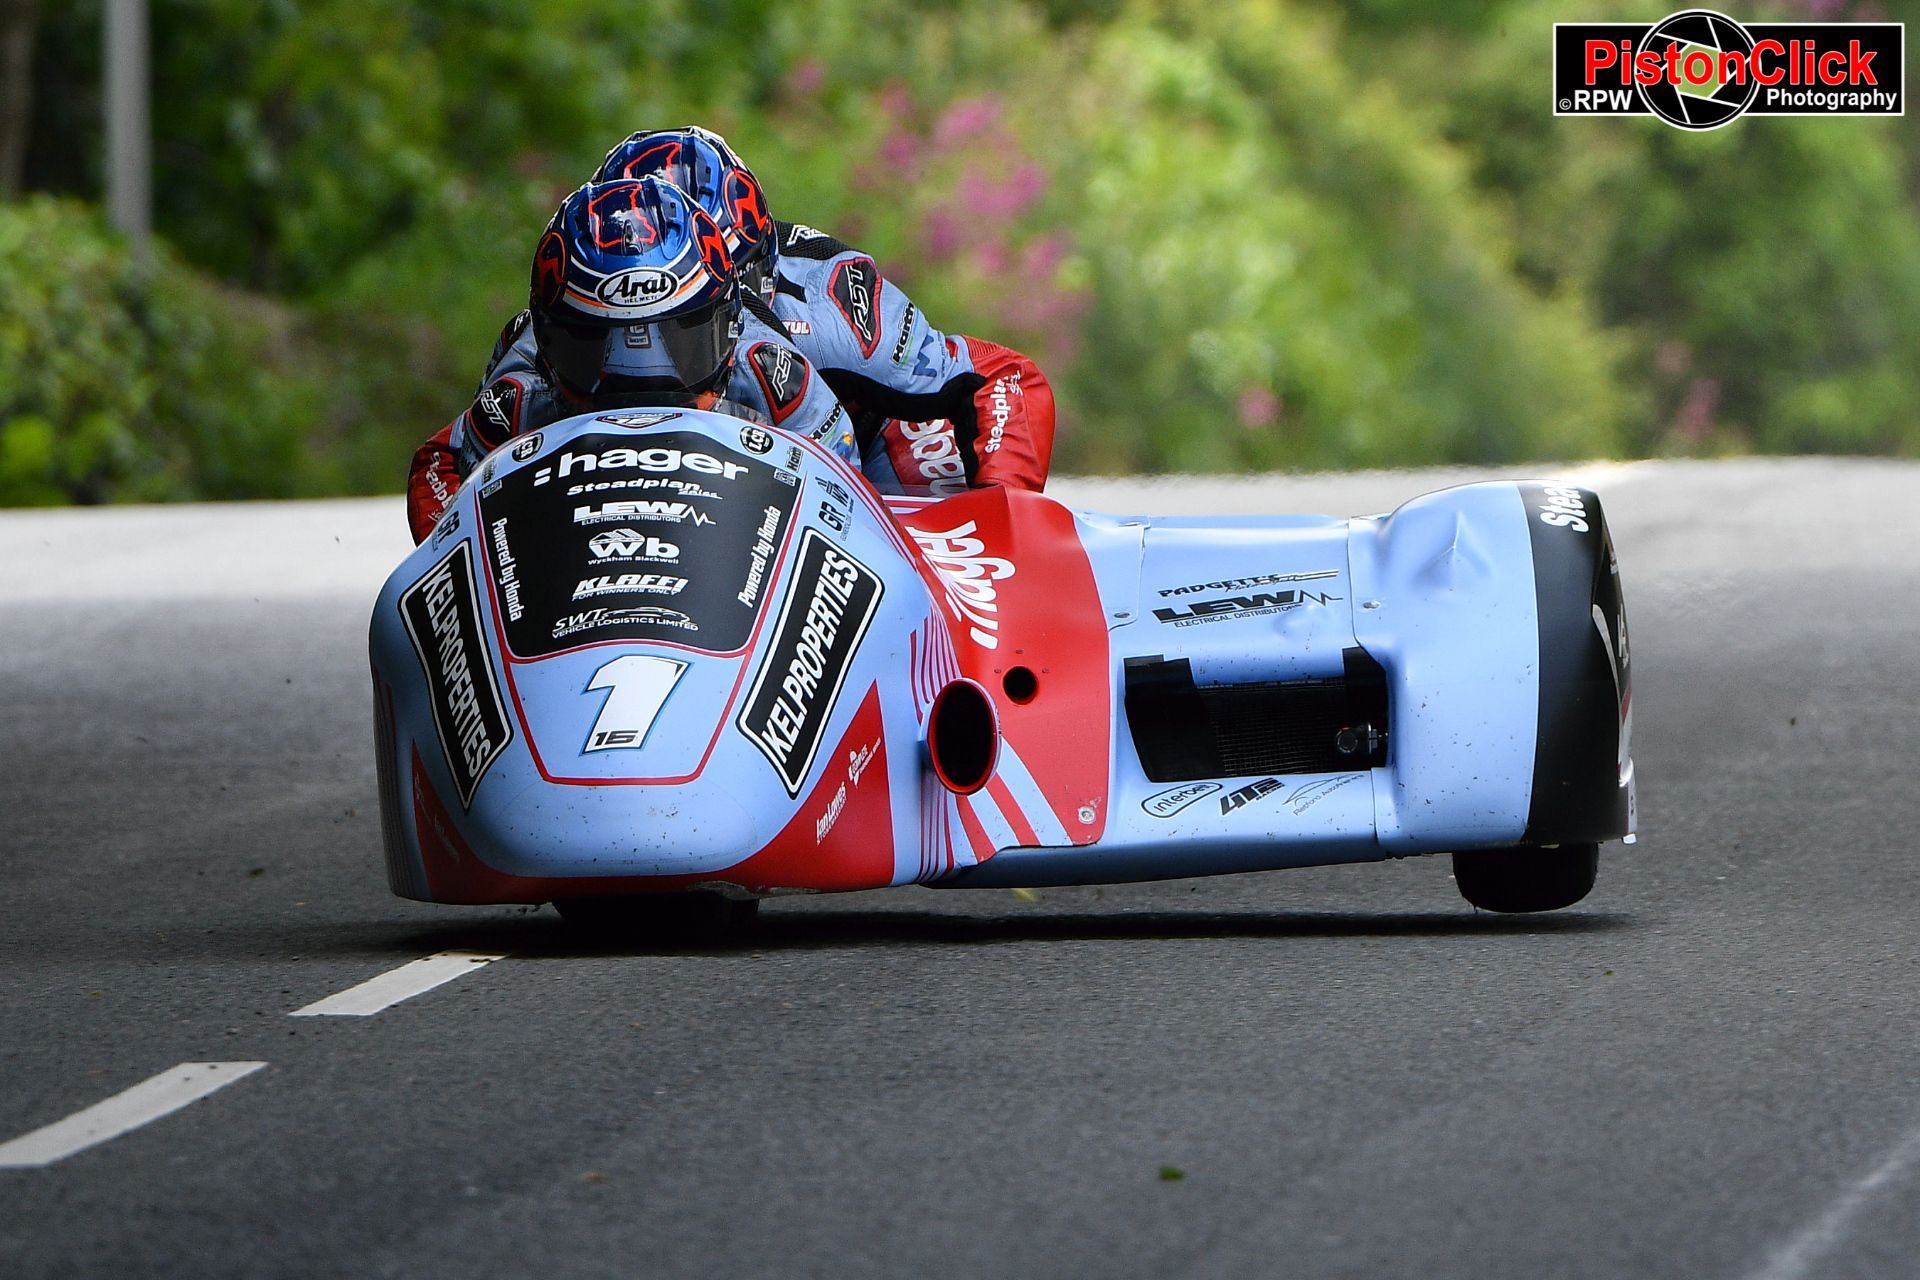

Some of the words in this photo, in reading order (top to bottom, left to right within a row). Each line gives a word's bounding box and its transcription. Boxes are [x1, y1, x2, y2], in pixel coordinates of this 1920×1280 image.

[603, 272, 669, 300] Arai
[844, 264, 872, 341] RST
[558, 448, 749, 481] hager
[567, 478, 701, 496] Steadplan
[574, 501, 688, 521] LEW
[582, 515, 626, 526] ELECTRICAL
[628, 514, 681, 523] DISTRIBUTORS
[757, 505, 782, 544] Honda
[491, 517, 516, 567] Powered
[752, 538, 775, 558] by
[499, 563, 517, 586] by
[588, 556, 633, 566] Wyckham
[635, 556, 680, 565] Blackwell
[600, 587, 644, 596] WINNERS
[737, 551, 767, 608] Powered
[504, 579, 525, 622] Honda
[1152, 590, 1296, 621] LEW
[552, 619, 595, 639] VEHICLE
[598, 616, 655, 626] LOGISTICS
[657, 617, 699, 632] LIMITED
[553, 607, 608, 633] SWT
[1174, 615, 1232, 628] ELECTRICAL
[761, 549, 860, 764] KELPROPERTIES
[422, 563, 492, 778] KELPROPERTIES
[584, 655, 692, 754] 1
[595, 730, 639, 747] 15
